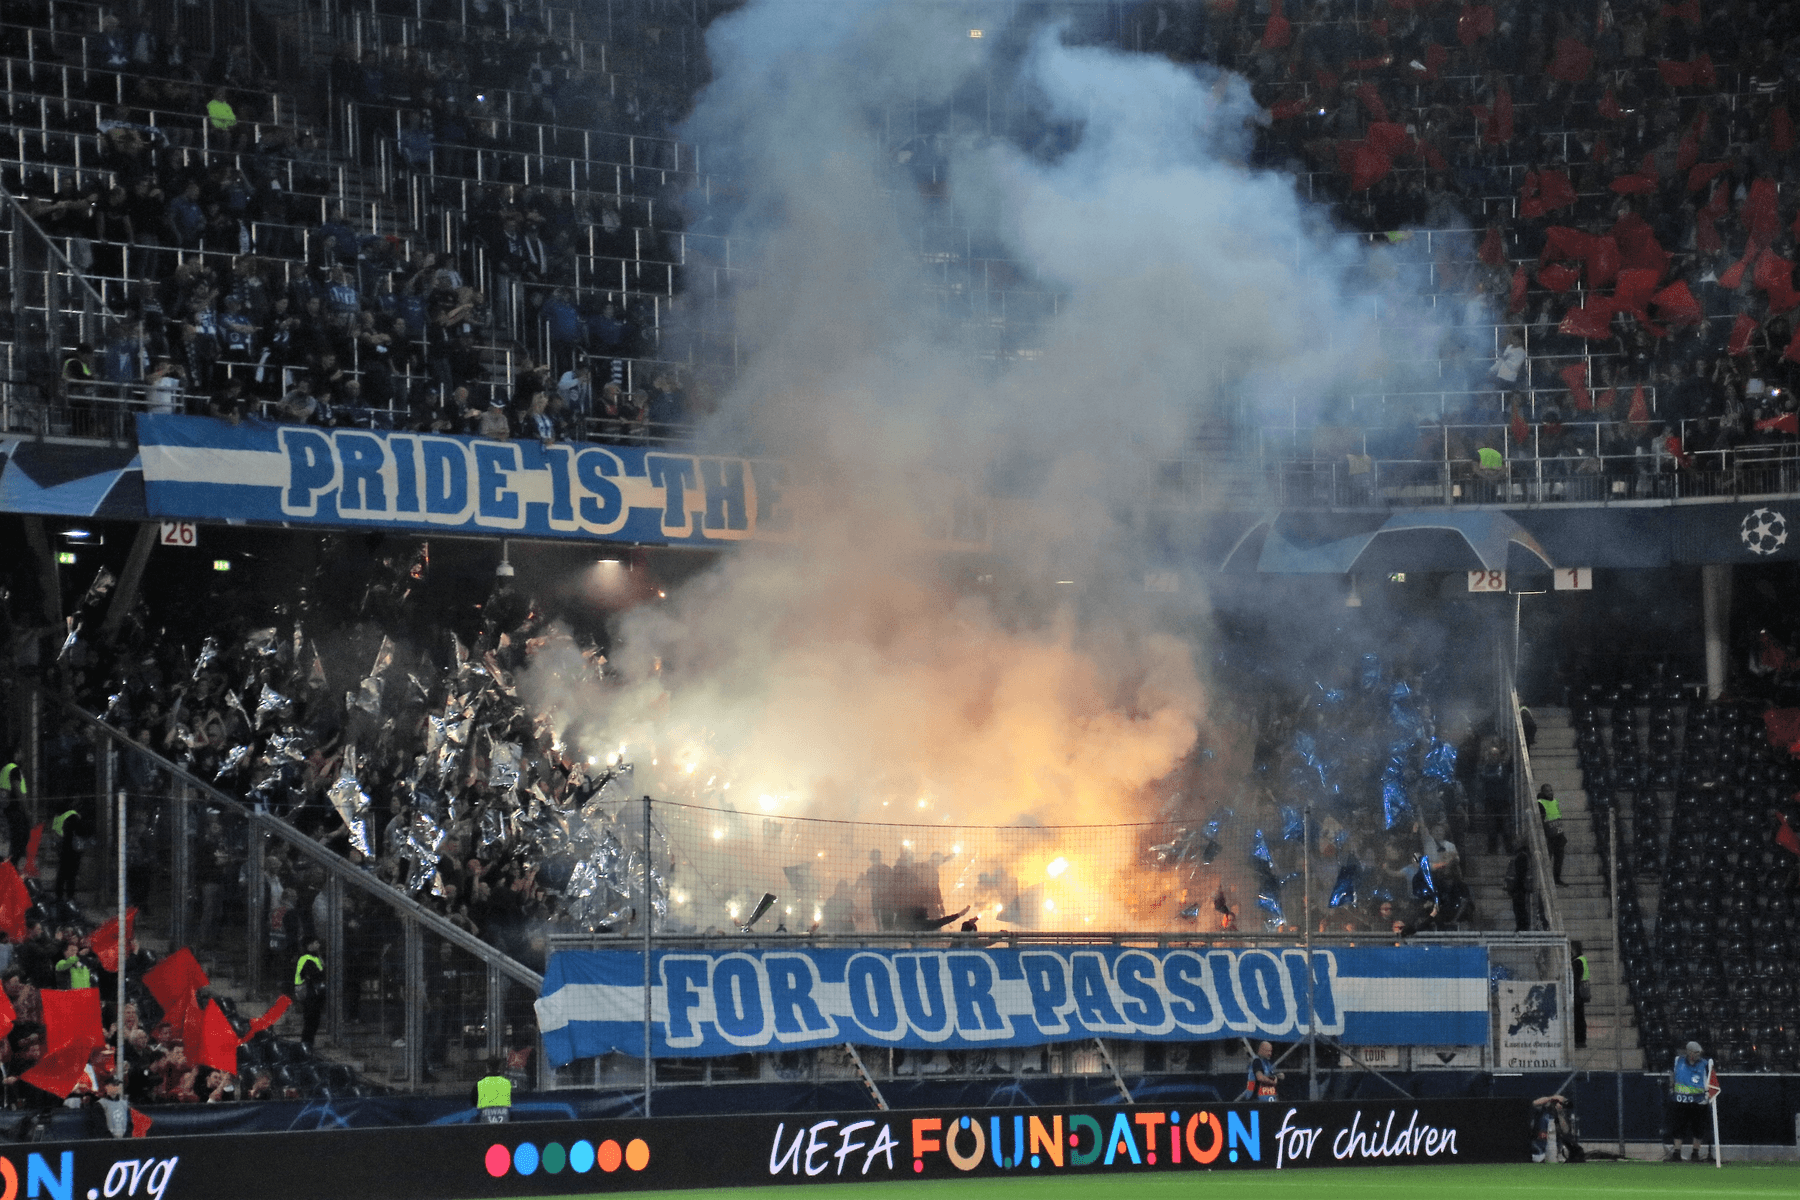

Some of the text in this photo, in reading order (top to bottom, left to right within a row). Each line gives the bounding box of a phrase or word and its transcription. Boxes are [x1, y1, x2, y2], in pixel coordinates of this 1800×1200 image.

[278, 427, 526, 528] PRIDE
[537, 443, 626, 534] IS
[165, 521, 193, 544] 26
[1472, 569, 1503, 590] 28
[1567, 567, 1579, 588] 1
[659, 949, 1345, 1047] FOR OUR PASSION
[769, 1108, 1458, 1176] UEFA FOUNDATION for children
